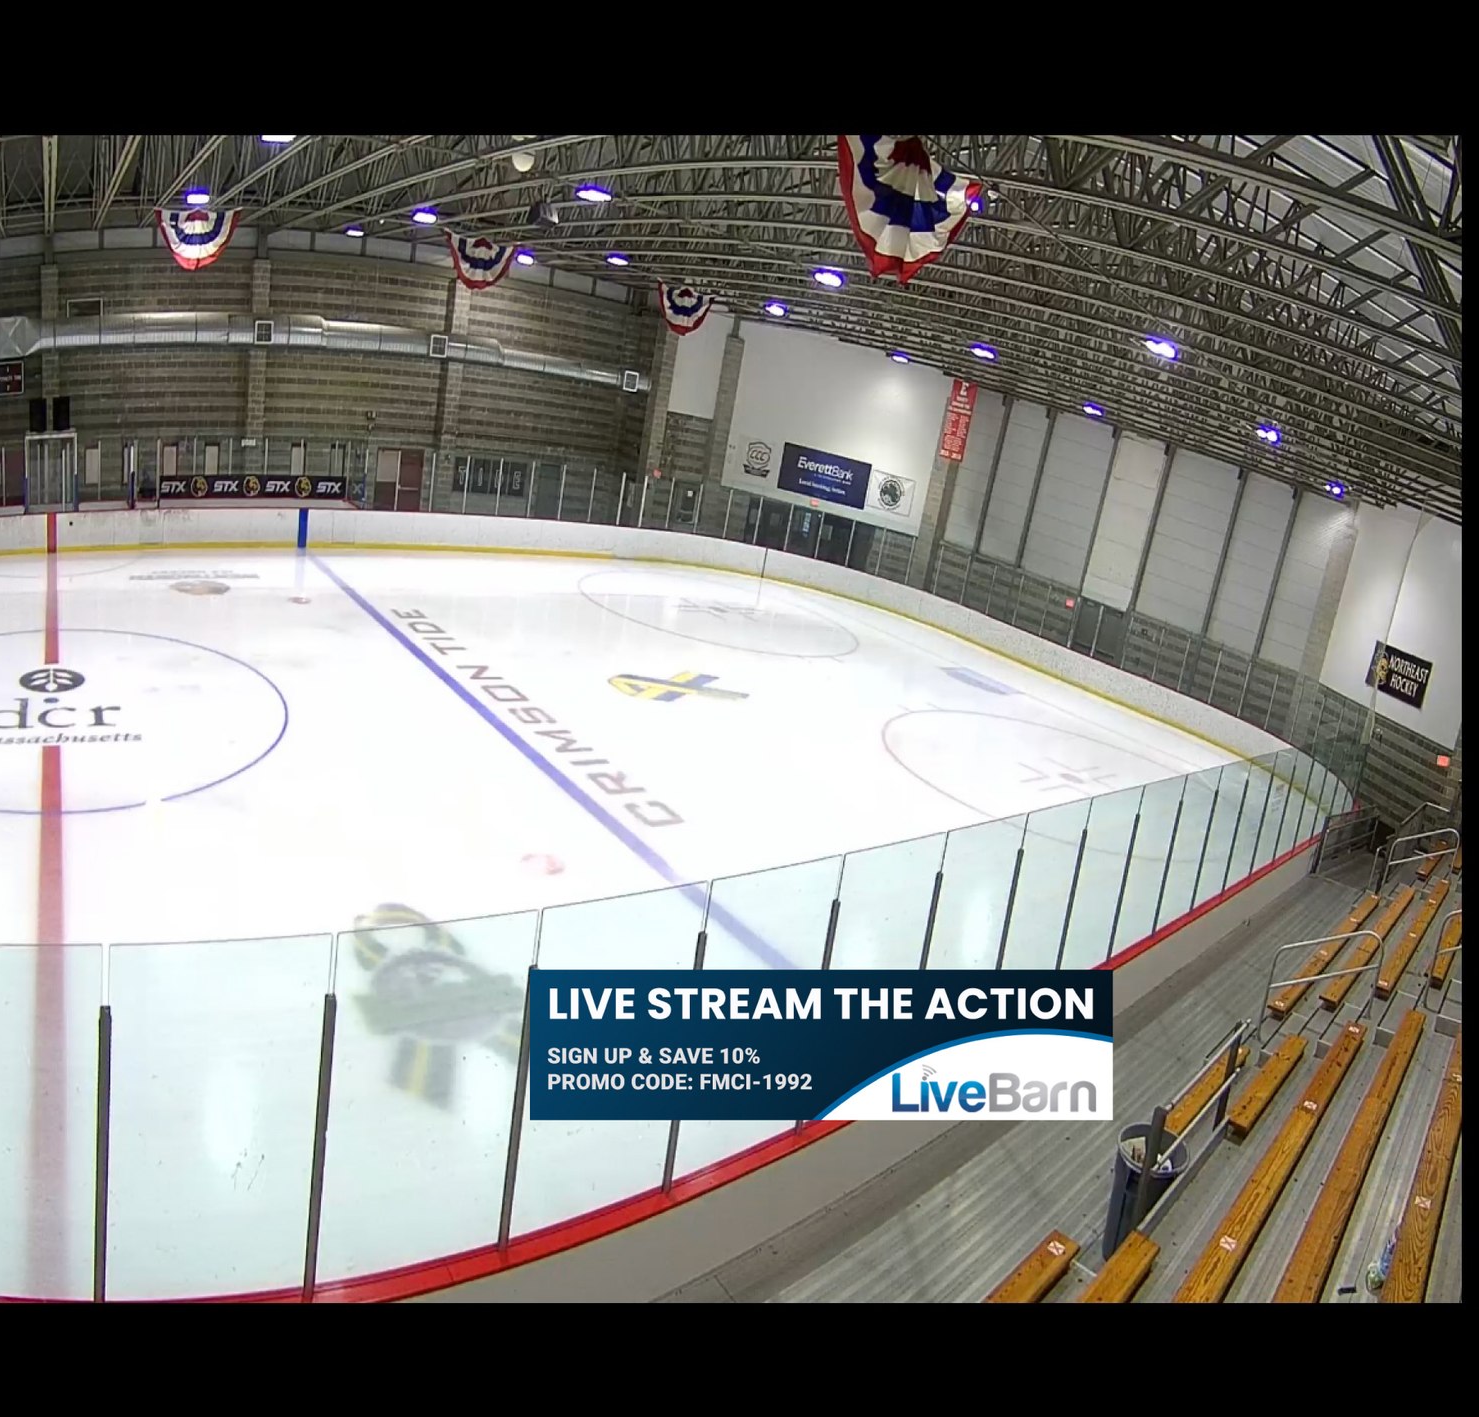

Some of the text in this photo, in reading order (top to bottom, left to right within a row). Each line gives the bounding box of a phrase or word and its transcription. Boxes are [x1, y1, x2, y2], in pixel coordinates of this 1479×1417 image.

[797, 455, 853, 481] EverettBank
[161, 480, 342, 494] STX STX STX STX
[1389, 654, 1428, 684] NORTHEAST
[1390, 673, 1419, 698] HOCKEY
[391, 607, 685, 828] CRIMSON TIDE
